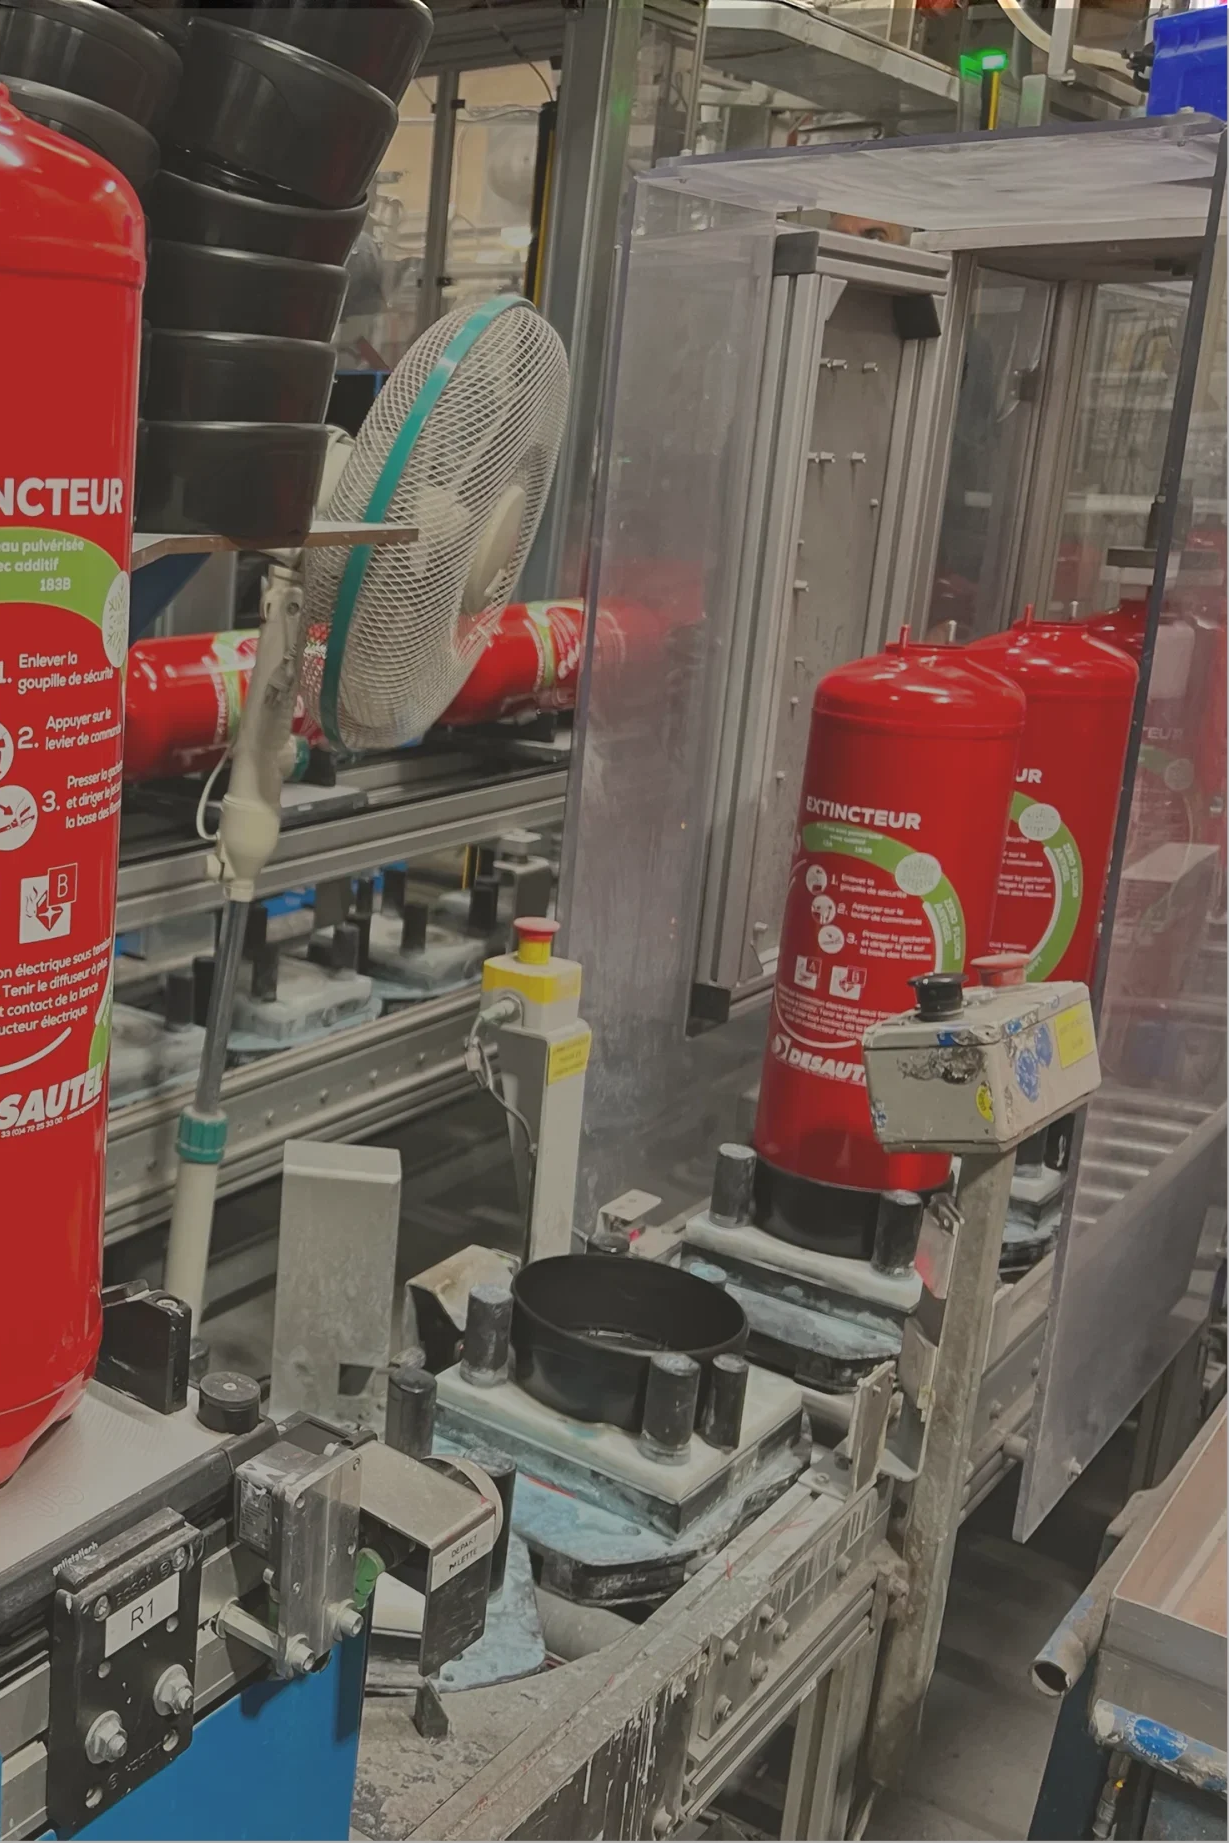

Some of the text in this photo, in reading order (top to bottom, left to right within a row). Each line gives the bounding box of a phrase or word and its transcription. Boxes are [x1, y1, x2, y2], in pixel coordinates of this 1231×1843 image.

[22, 537, 84, 555] pulvérisée
[14, 557, 59, 571] additif
[40, 577, 71, 591] 183B
[19, 653, 66, 669] Enlever
[68, 651, 78, 665] la
[18, 666, 114, 695] goupille de sécurité
[18, 706, 111, 749] 2. Appuyer sur le
[45, 735, 76, 750] levier
[77, 732, 89, 746] de
[41, 790, 61, 812] 3.
[67, 772, 100, 790] Presser
[101, 768, 107, 781] la
[66, 796, 77, 810] et
[79, 790, 105, 808] diriger
[104, 786, 110, 799] le
[65, 815, 75, 829] la
[77, 812, 97, 827] base
[97, 806, 109, 820] des
[806, 796, 922, 830] EXTINCTEUR
[57, 874, 68, 898] B
[15, 956, 71, 977] électrique
[73, 949, 91, 964] sous
[2, 982, 35, 998] Tenir
[37, 980, 47, 992] le
[49, 966, 91, 990] diffuseur
[91, 965, 97, 976] à
[97, 957, 109, 976] plus
[7, 998, 53, 1016] contact
[55, 994, 67, 1007] de
[69, 990, 77, 1002] la
[79, 982, 99, 998] lance
[41, 1004, 88, 1028] électrique
[789, 1047, 867, 1084] DESAUT
[1, 1130, 11, 1138] 33
[451, 1534, 477, 1558] DEPART
[52, 1541, 99, 1576] antistatisch
[131, 1598, 154, 1631] R1
